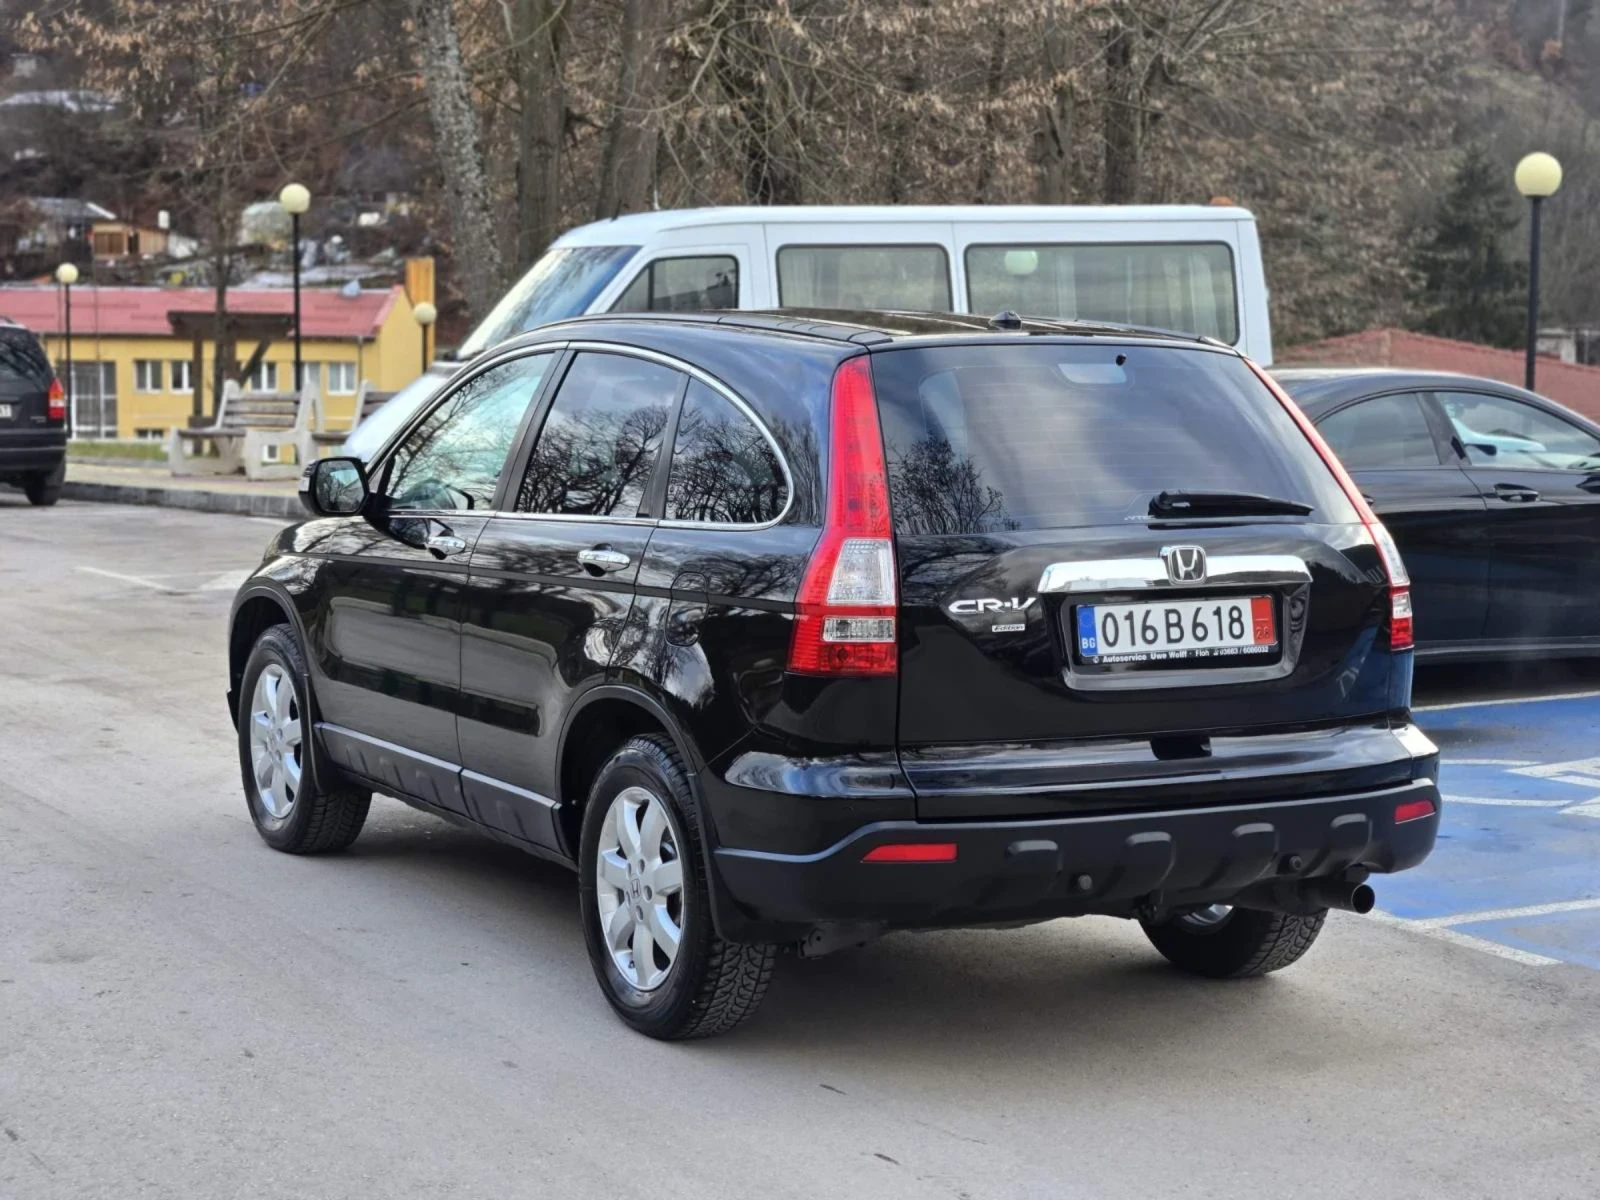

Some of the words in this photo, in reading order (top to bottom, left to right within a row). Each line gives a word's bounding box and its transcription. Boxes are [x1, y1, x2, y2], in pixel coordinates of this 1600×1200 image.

[948, 597, 1037, 614] CR-V
[1101, 605, 1246, 648] 016B618
[1081, 637, 1096, 649] BG
[1102, 653, 1147, 663] Autoservice
[1150, 652, 1167, 660] Uwe
[1168, 650, 1188, 659] Wolff
[1195, 649, 1210, 657] Floh
